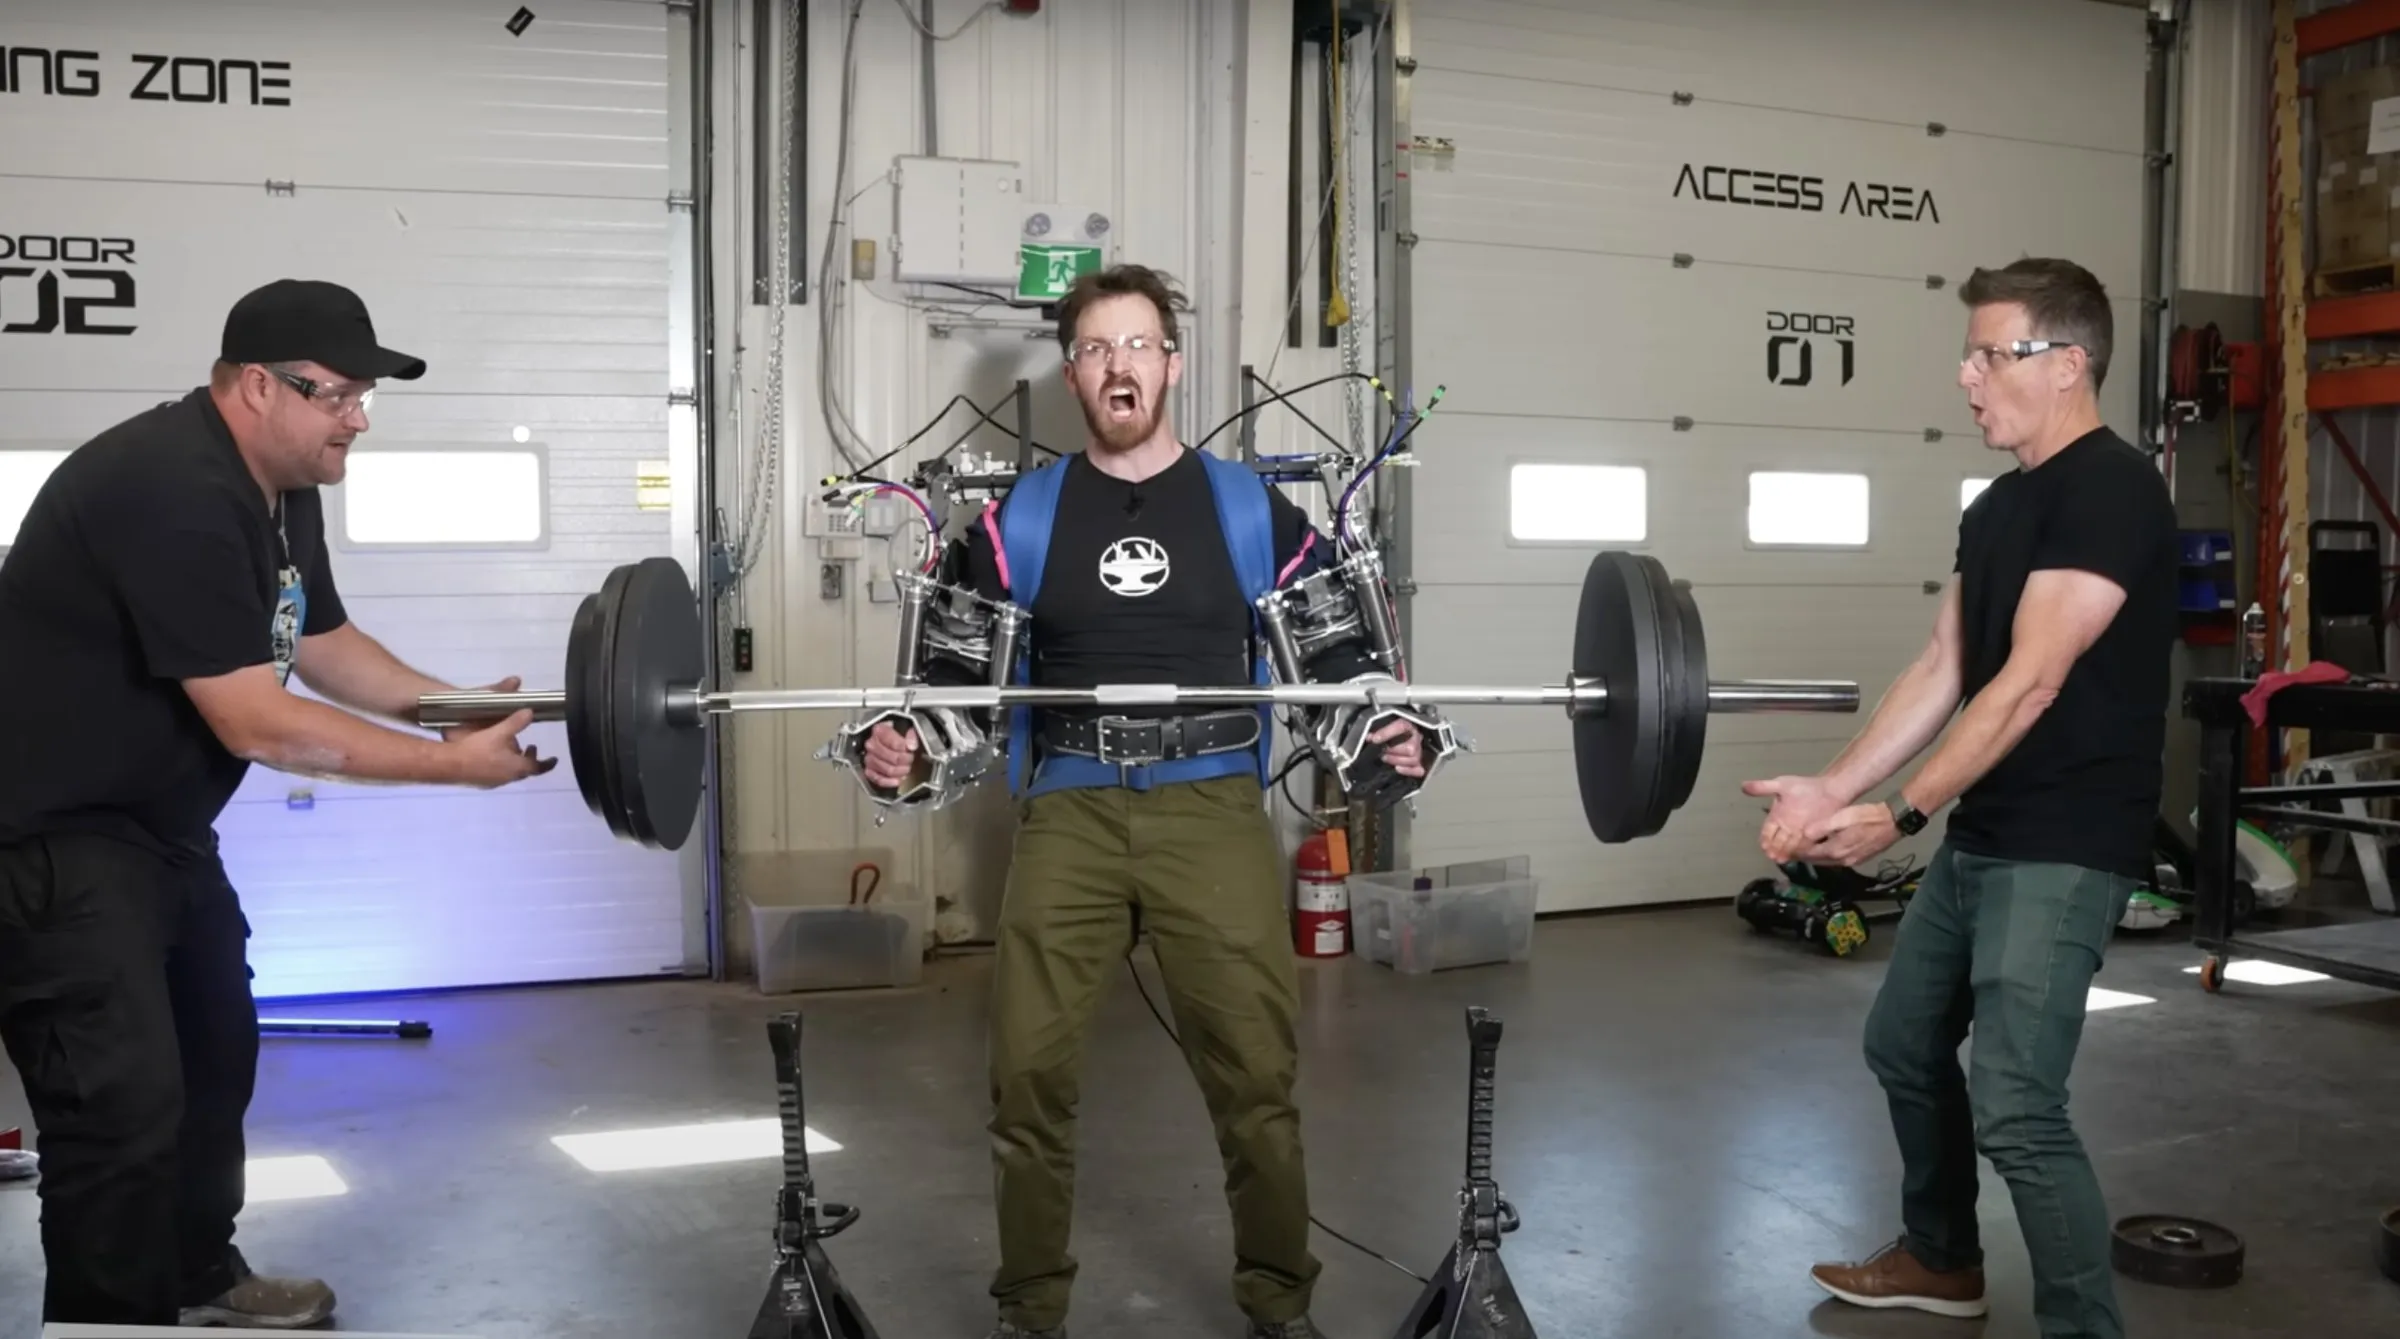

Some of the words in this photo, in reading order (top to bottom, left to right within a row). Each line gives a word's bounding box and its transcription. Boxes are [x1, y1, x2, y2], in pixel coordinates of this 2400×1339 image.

[130, 54, 291, 106] ZONE
[1673, 163, 1824, 212] ACCESS
[1840, 181, 1940, 224] AREA
[0, 267, 138, 335] 02
[1766, 311, 1855, 336] DOOR
[1767, 336, 1854, 387] 01
